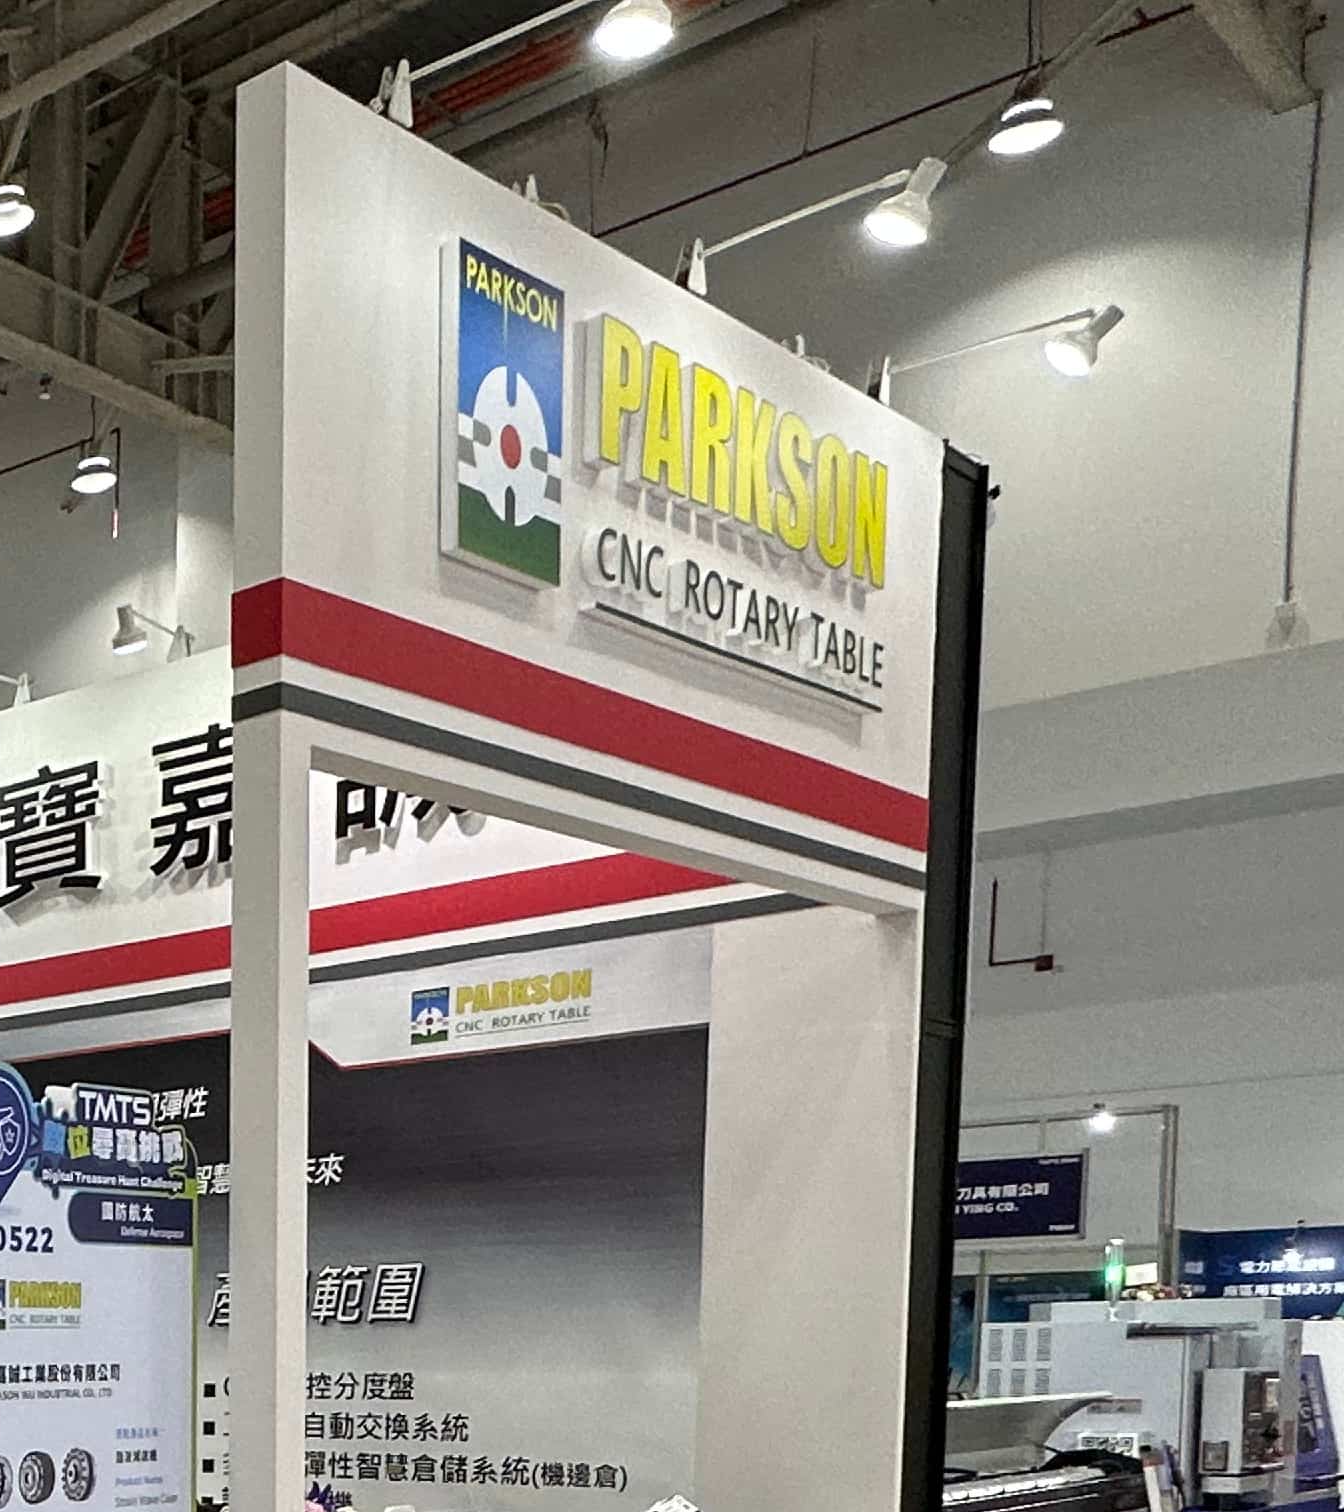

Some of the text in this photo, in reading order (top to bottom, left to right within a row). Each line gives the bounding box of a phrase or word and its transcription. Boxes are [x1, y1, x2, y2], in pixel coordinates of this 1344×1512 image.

[464, 254, 559, 331] PARKSON
[599, 314, 888, 590] PARKSON
[596, 528, 885, 690] CNC ROTARY TABLE
[455, 1005, 591, 1033] CNC ROTARY TABLE
[456, 968, 592, 1015] PARKSON
[79, 1091, 151, 1125] TMTS
